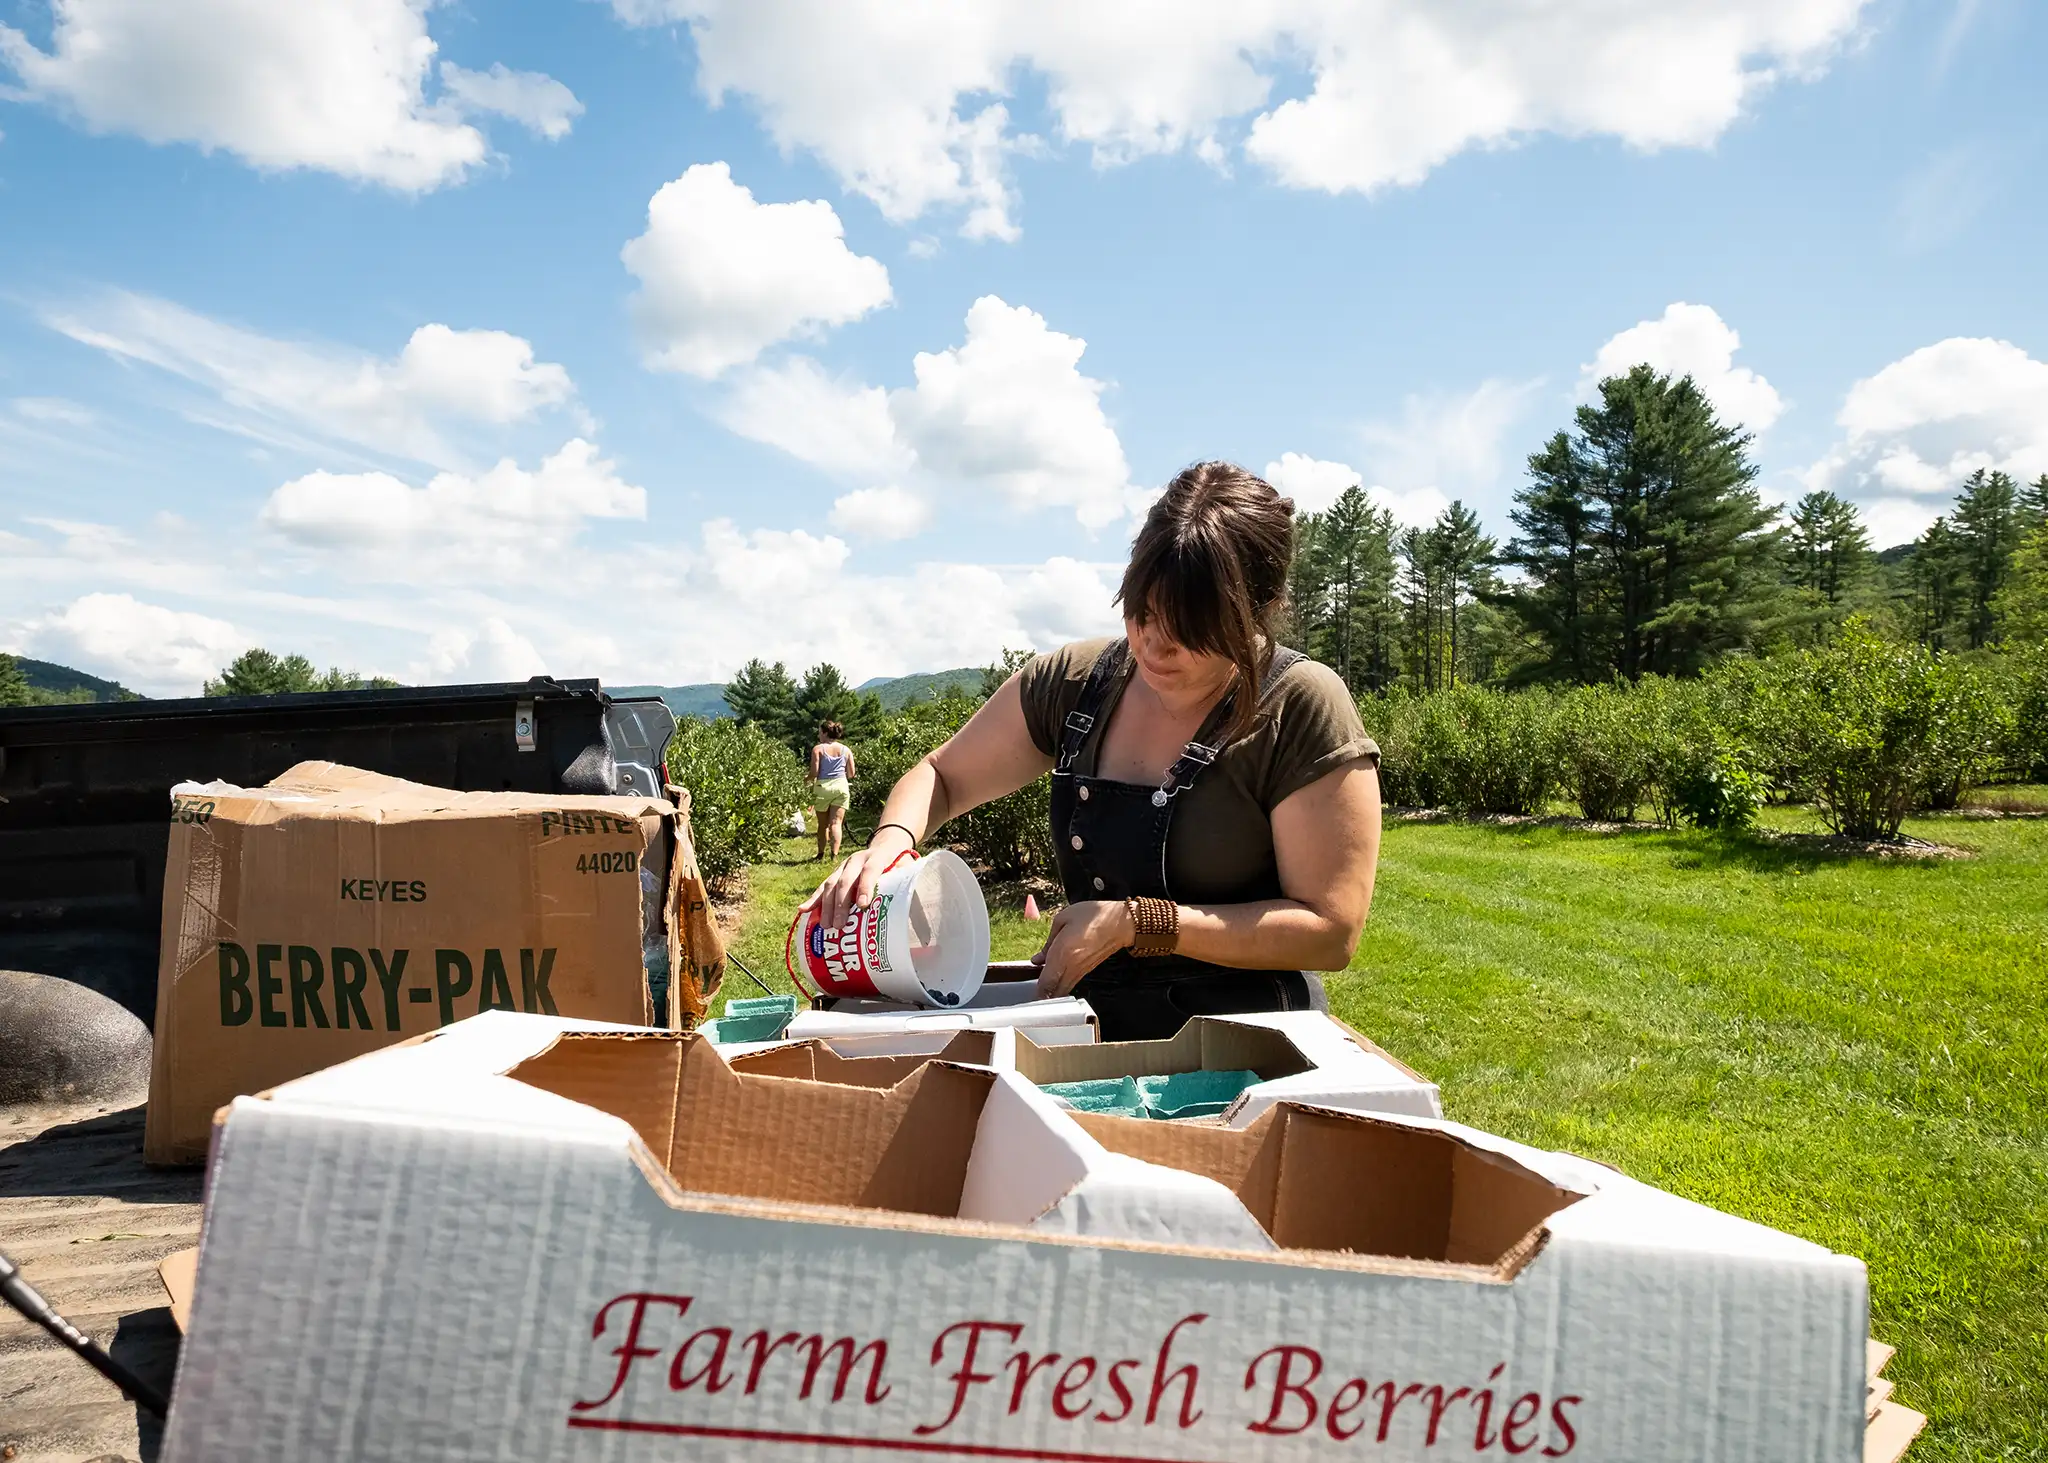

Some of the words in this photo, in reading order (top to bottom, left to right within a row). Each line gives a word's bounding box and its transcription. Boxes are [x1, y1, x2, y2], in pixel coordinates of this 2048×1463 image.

[341, 878, 427, 902] KEYES
[576, 851, 636, 875] 44020
[218, 942, 558, 1032] BERRY-PAK
[571, 1292, 892, 1412] Farm
[912, 1313, 1210, 1436] Fresh
[1244, 1344, 1584, 1457] Berries
